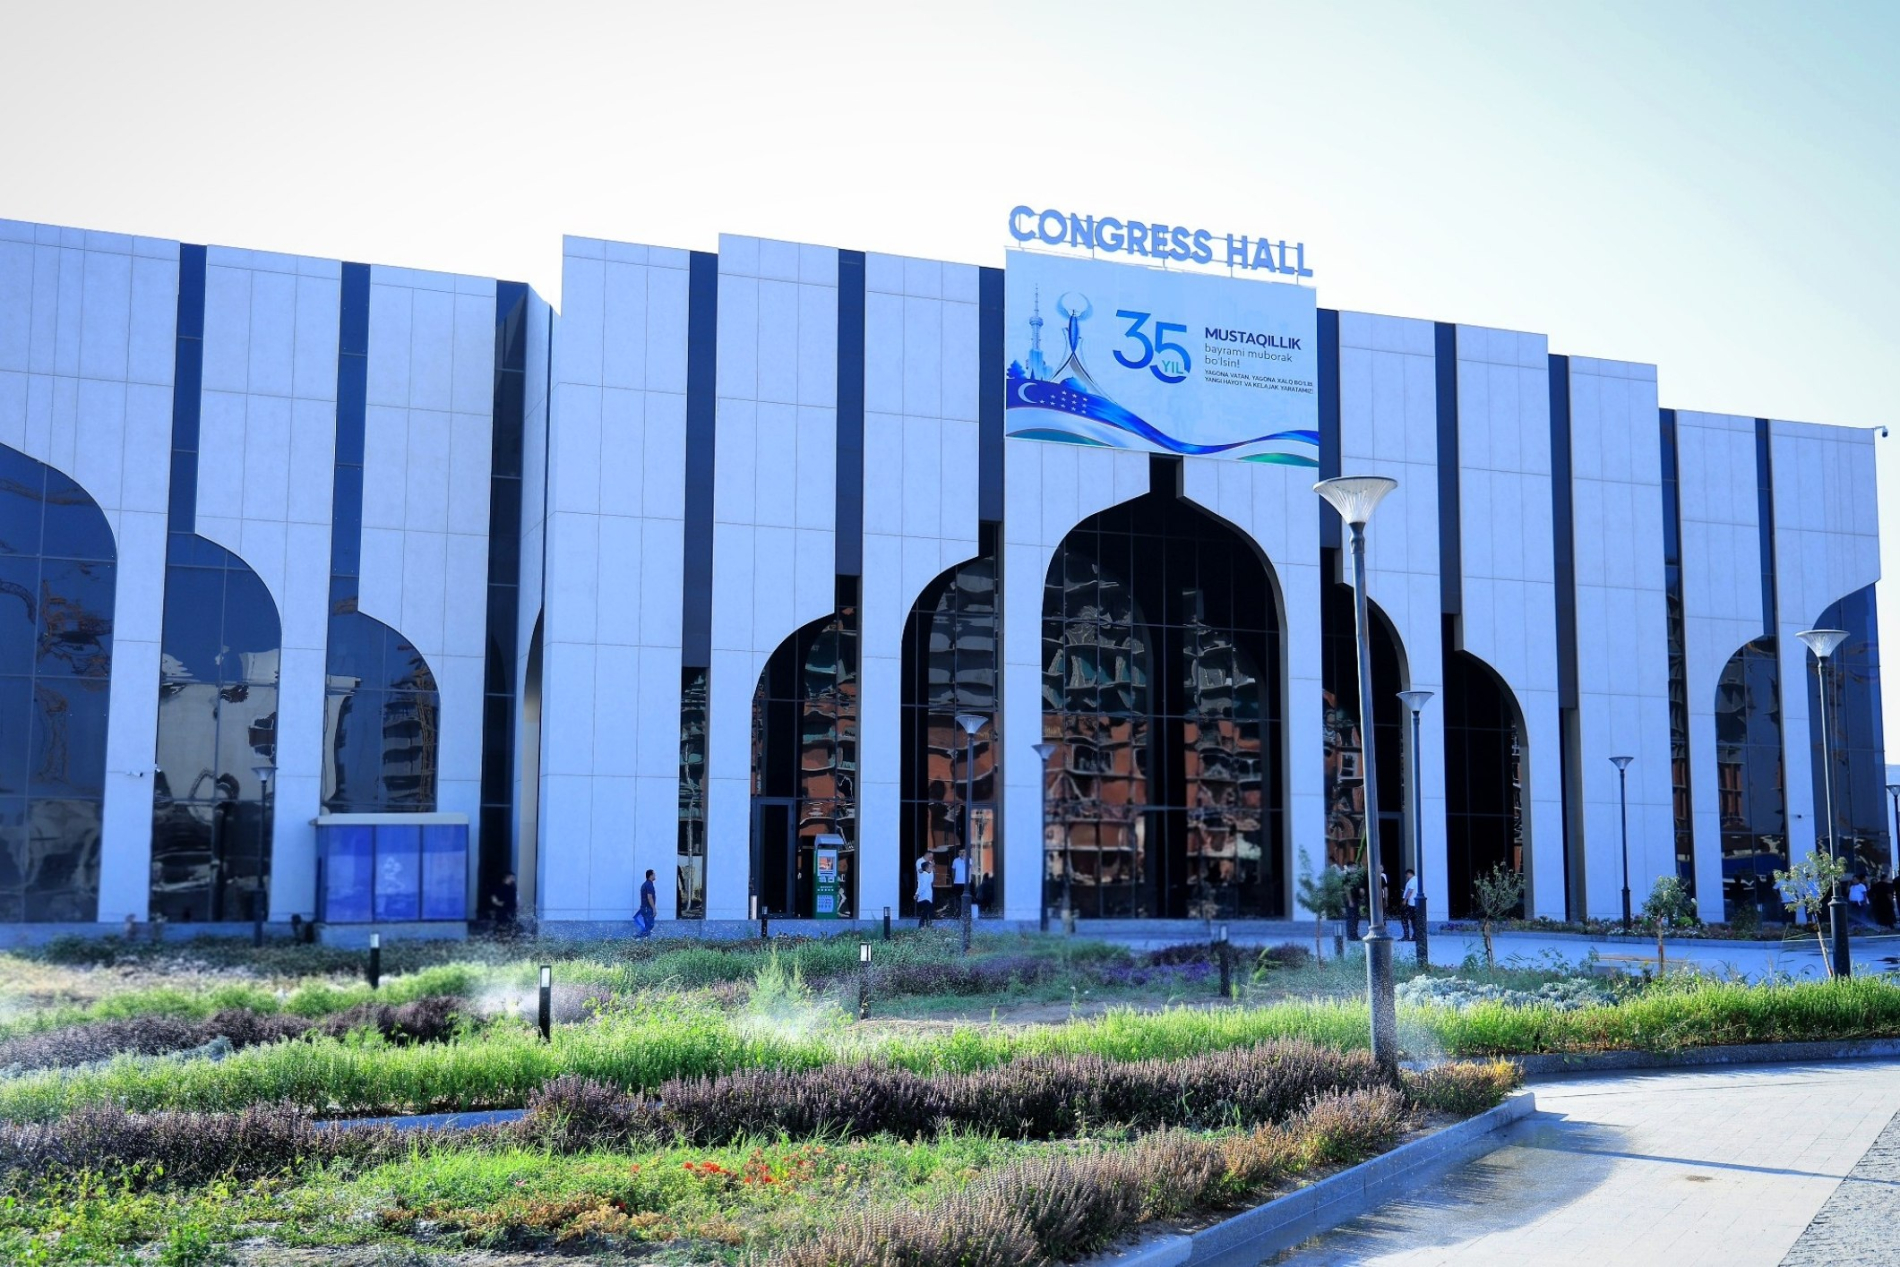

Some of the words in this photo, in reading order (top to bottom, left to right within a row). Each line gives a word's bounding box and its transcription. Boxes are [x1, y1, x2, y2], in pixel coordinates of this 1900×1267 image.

[1009, 205, 1212, 265] CONGRESS
[1227, 233, 1314, 277] HALL
[1112, 309, 1191, 384] 35
[1205, 327, 1301, 350] MUSTAQILLIK
[1204, 343, 1245, 356] bayrami
[1248, 350, 1292, 362] muborak
[1162, 360, 1184, 374] YIL
[1204, 369, 1229, 378] YAGONA
